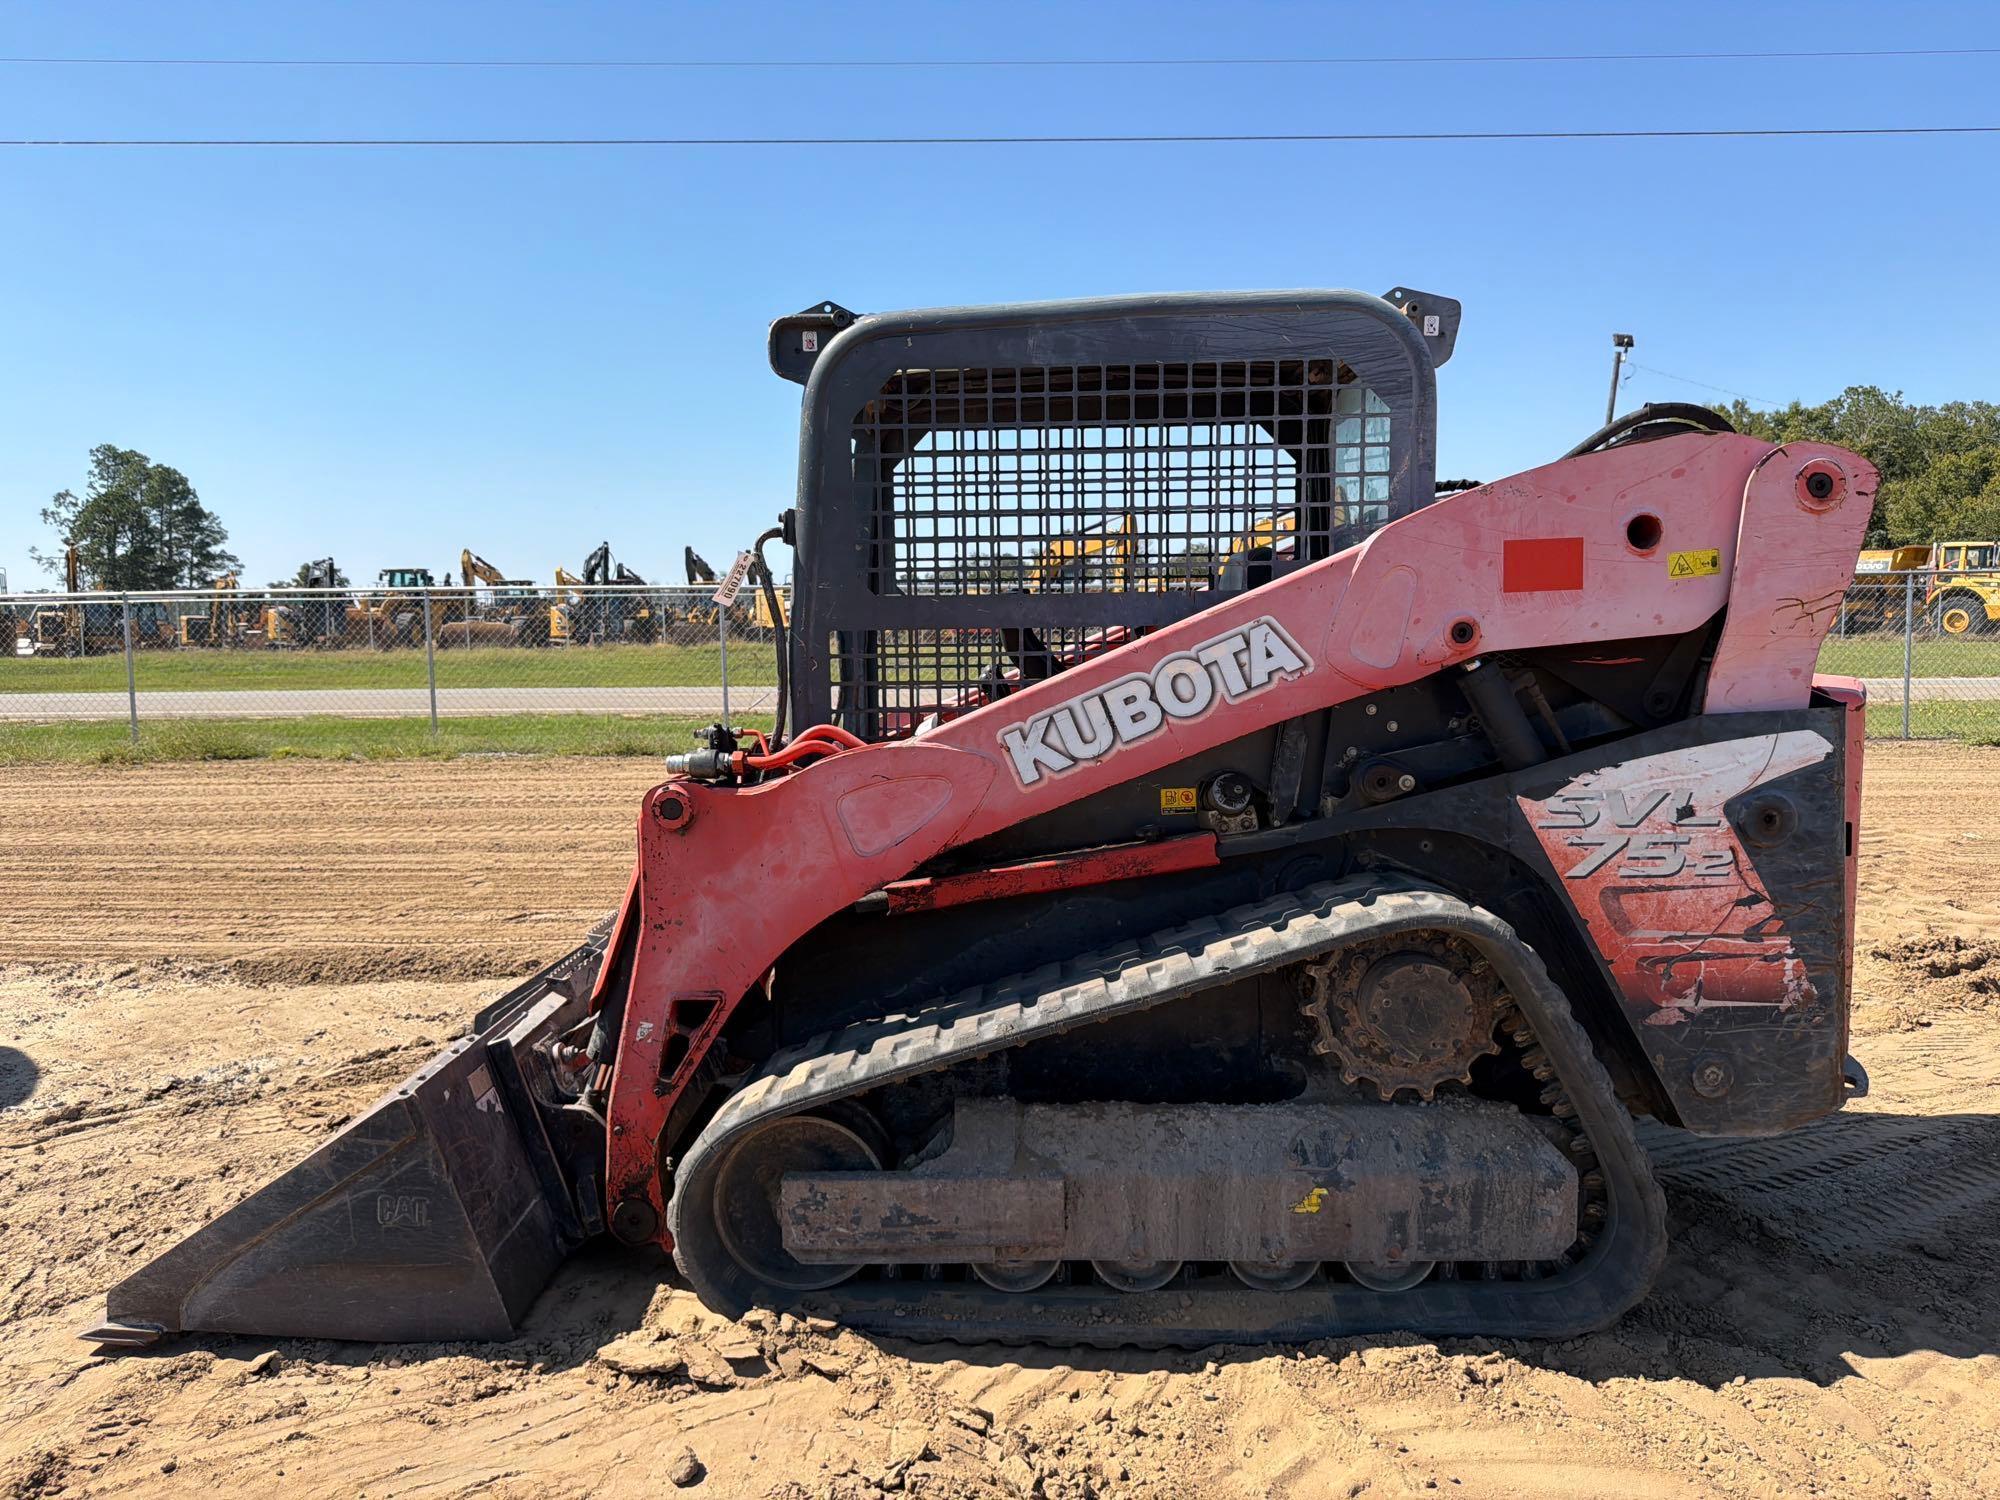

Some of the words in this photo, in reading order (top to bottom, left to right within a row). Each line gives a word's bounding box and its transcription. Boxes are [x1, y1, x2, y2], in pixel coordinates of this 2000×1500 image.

[1002, 622, 1306, 786] KUBOTA
[1538, 789, 1722, 829] SVL
[377, 1195, 430, 1228] CAT
